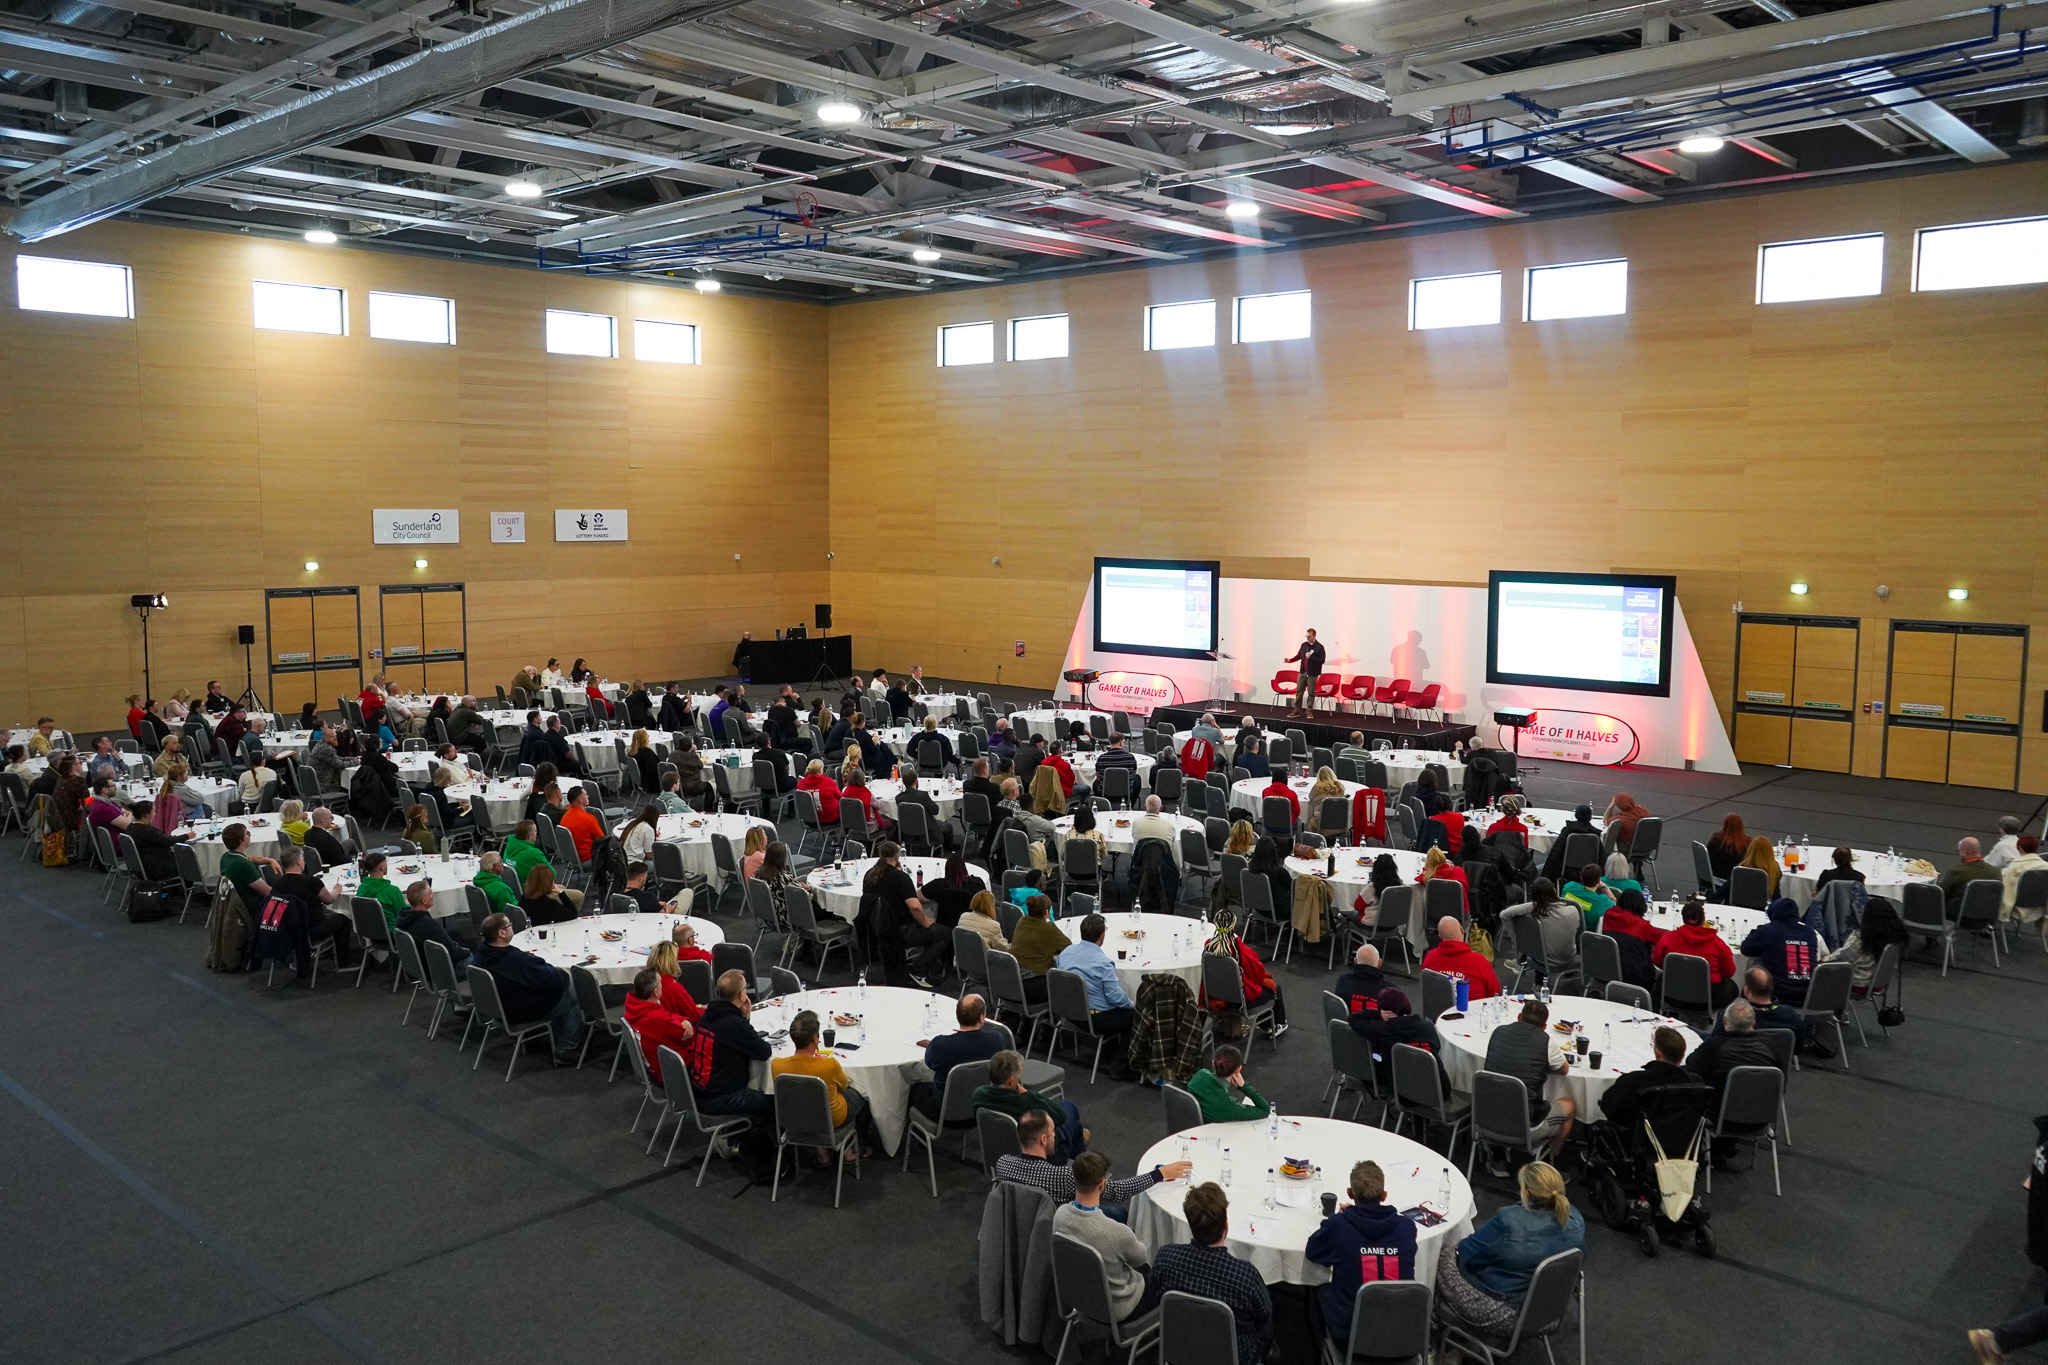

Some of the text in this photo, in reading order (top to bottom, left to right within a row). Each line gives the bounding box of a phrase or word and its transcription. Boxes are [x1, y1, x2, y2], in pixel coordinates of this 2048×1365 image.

[392, 521, 442, 531] Sunderland
[497, 517, 520, 525] COURT
[392, 532, 406, 540] City
[506, 526, 513, 538] 3
[1098, 683, 1121, 693] GAME
[1122, 685, 1134, 694] OF
[1141, 688, 1167, 697] HALVES
[1548, 727, 1563, 738] OF
[1576, 730, 1620, 743] HALVES
[1360, 1246, 1399, 1255] GAME OF
